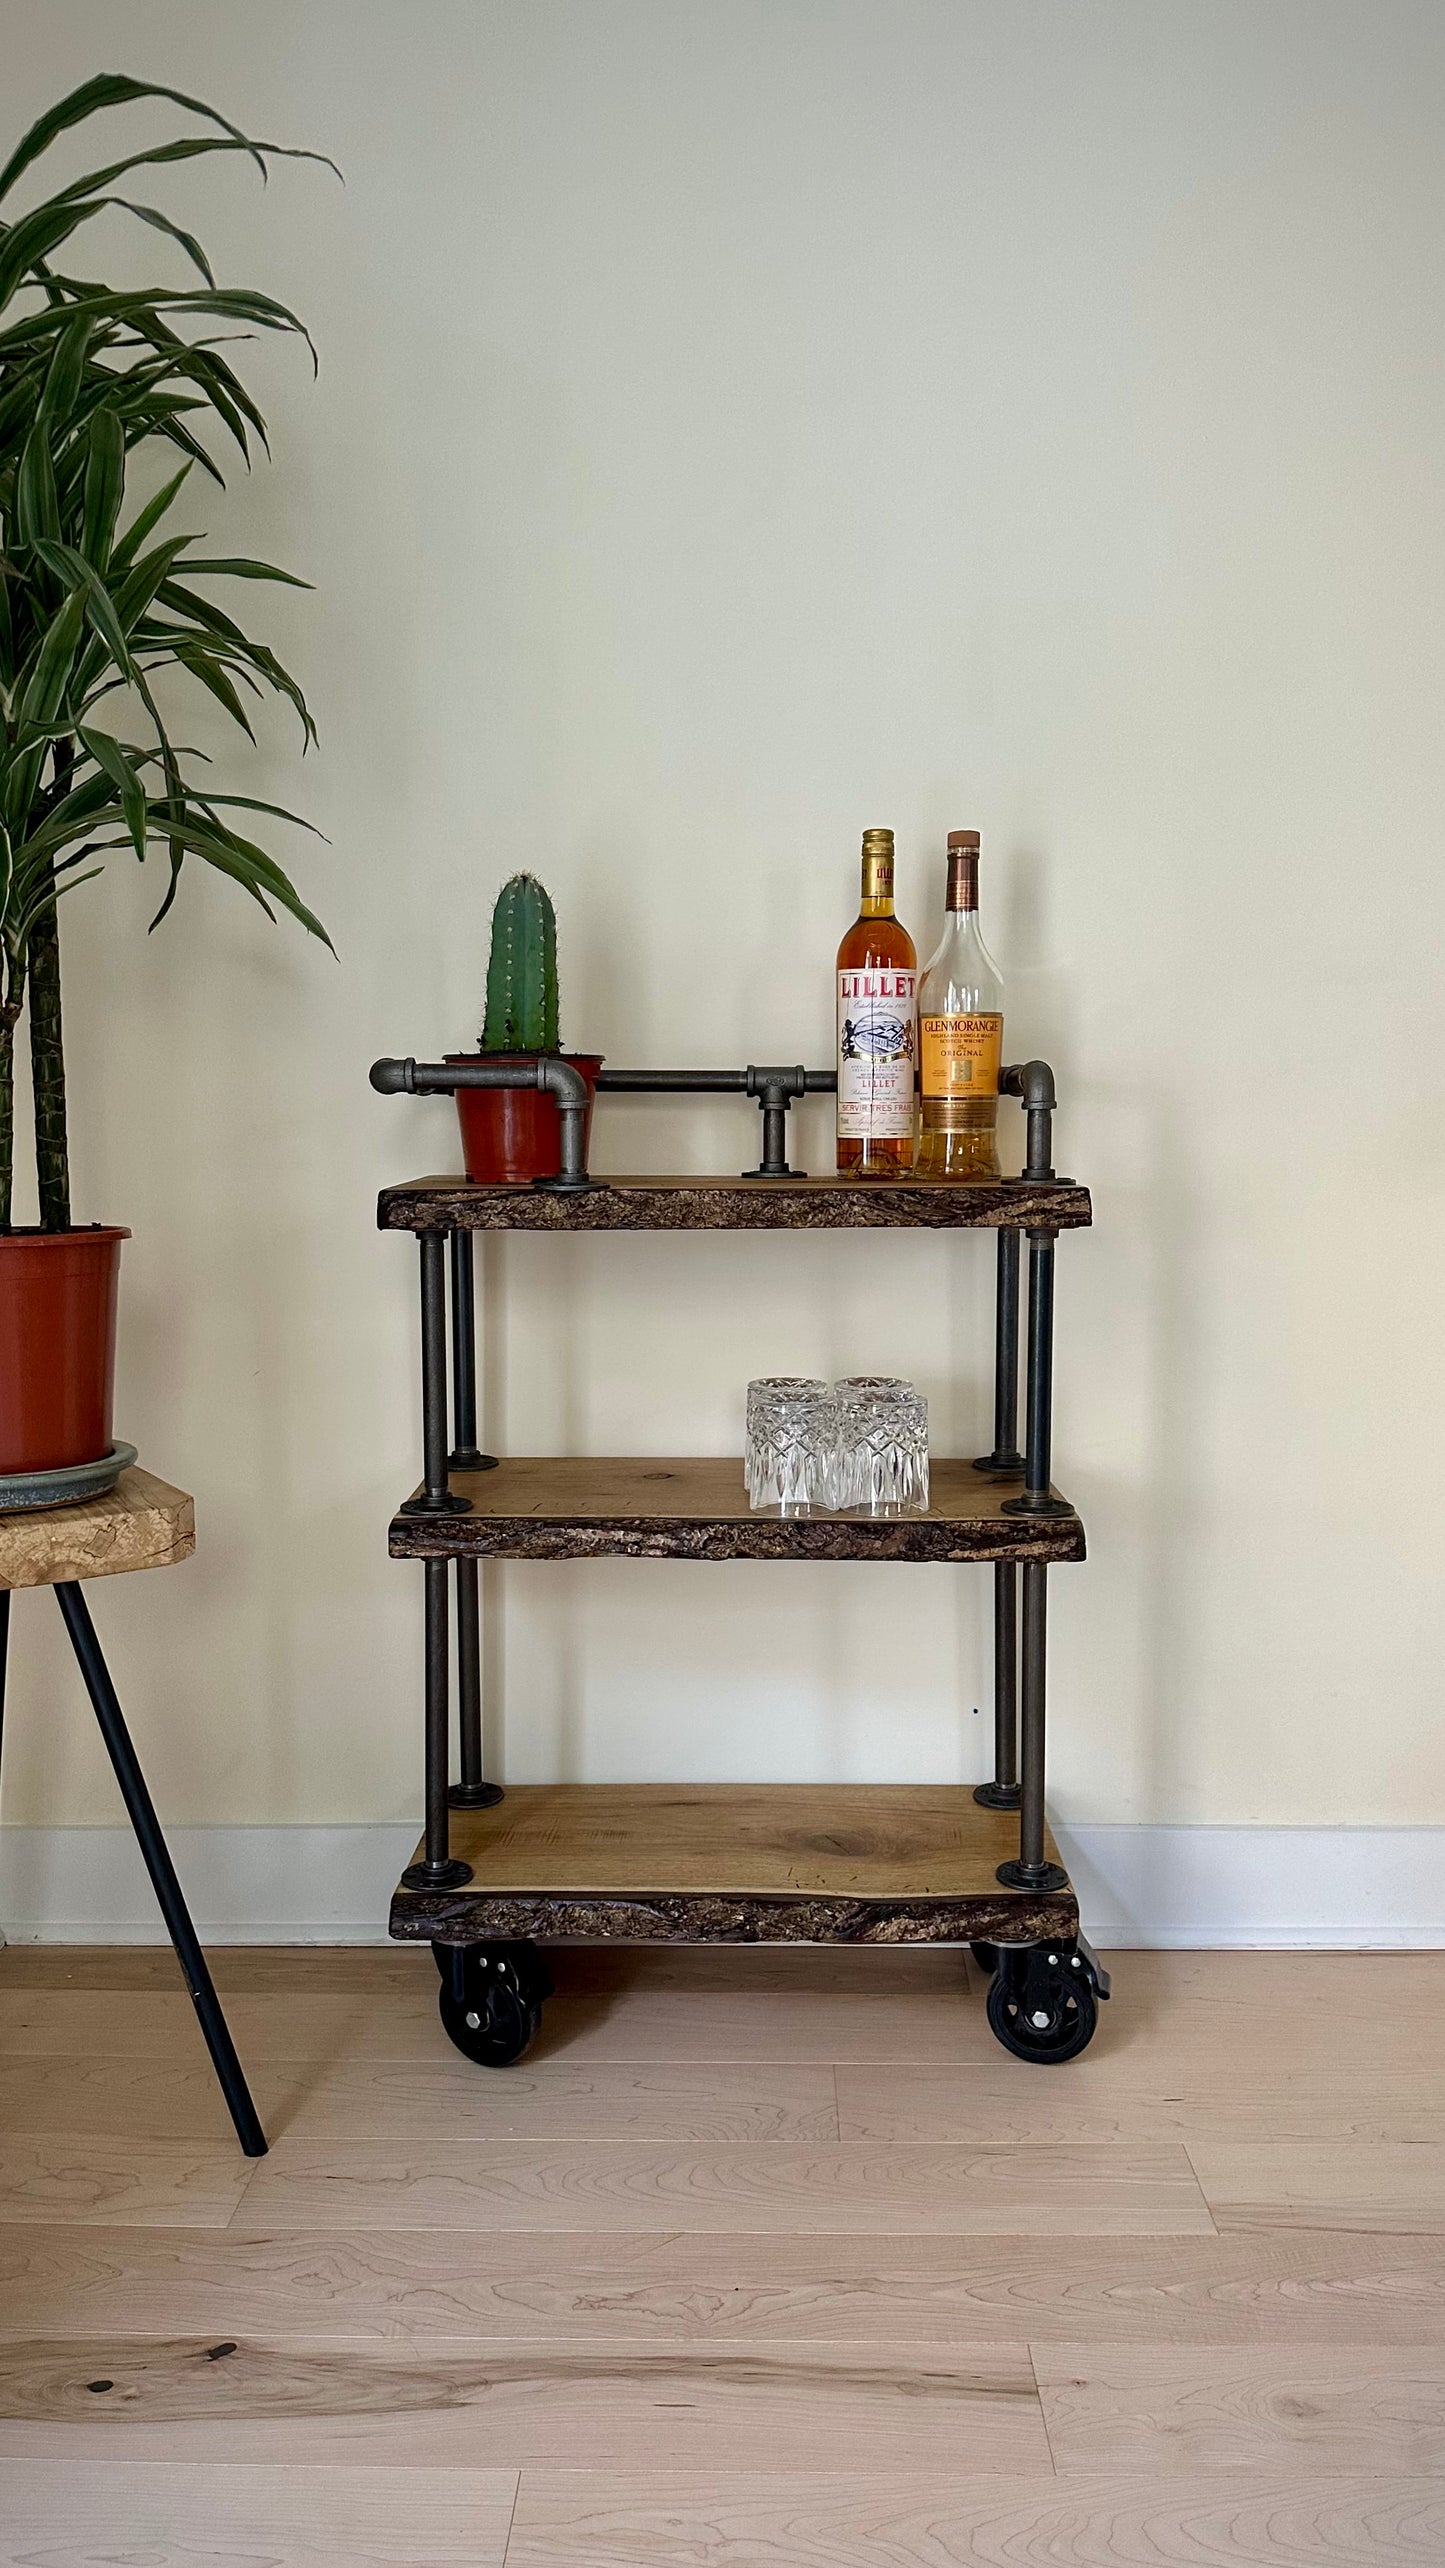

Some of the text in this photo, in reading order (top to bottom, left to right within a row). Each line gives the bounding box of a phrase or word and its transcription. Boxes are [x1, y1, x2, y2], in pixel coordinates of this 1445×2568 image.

[842, 976, 916, 998] LILLET
[924, 1020, 999, 1032] GLENMORANGIE
[862, 1079, 896, 1088] LILLET
[842, 1104, 868, 1112] SERVIR
[894, 1104, 912, 1112] FRAIS
